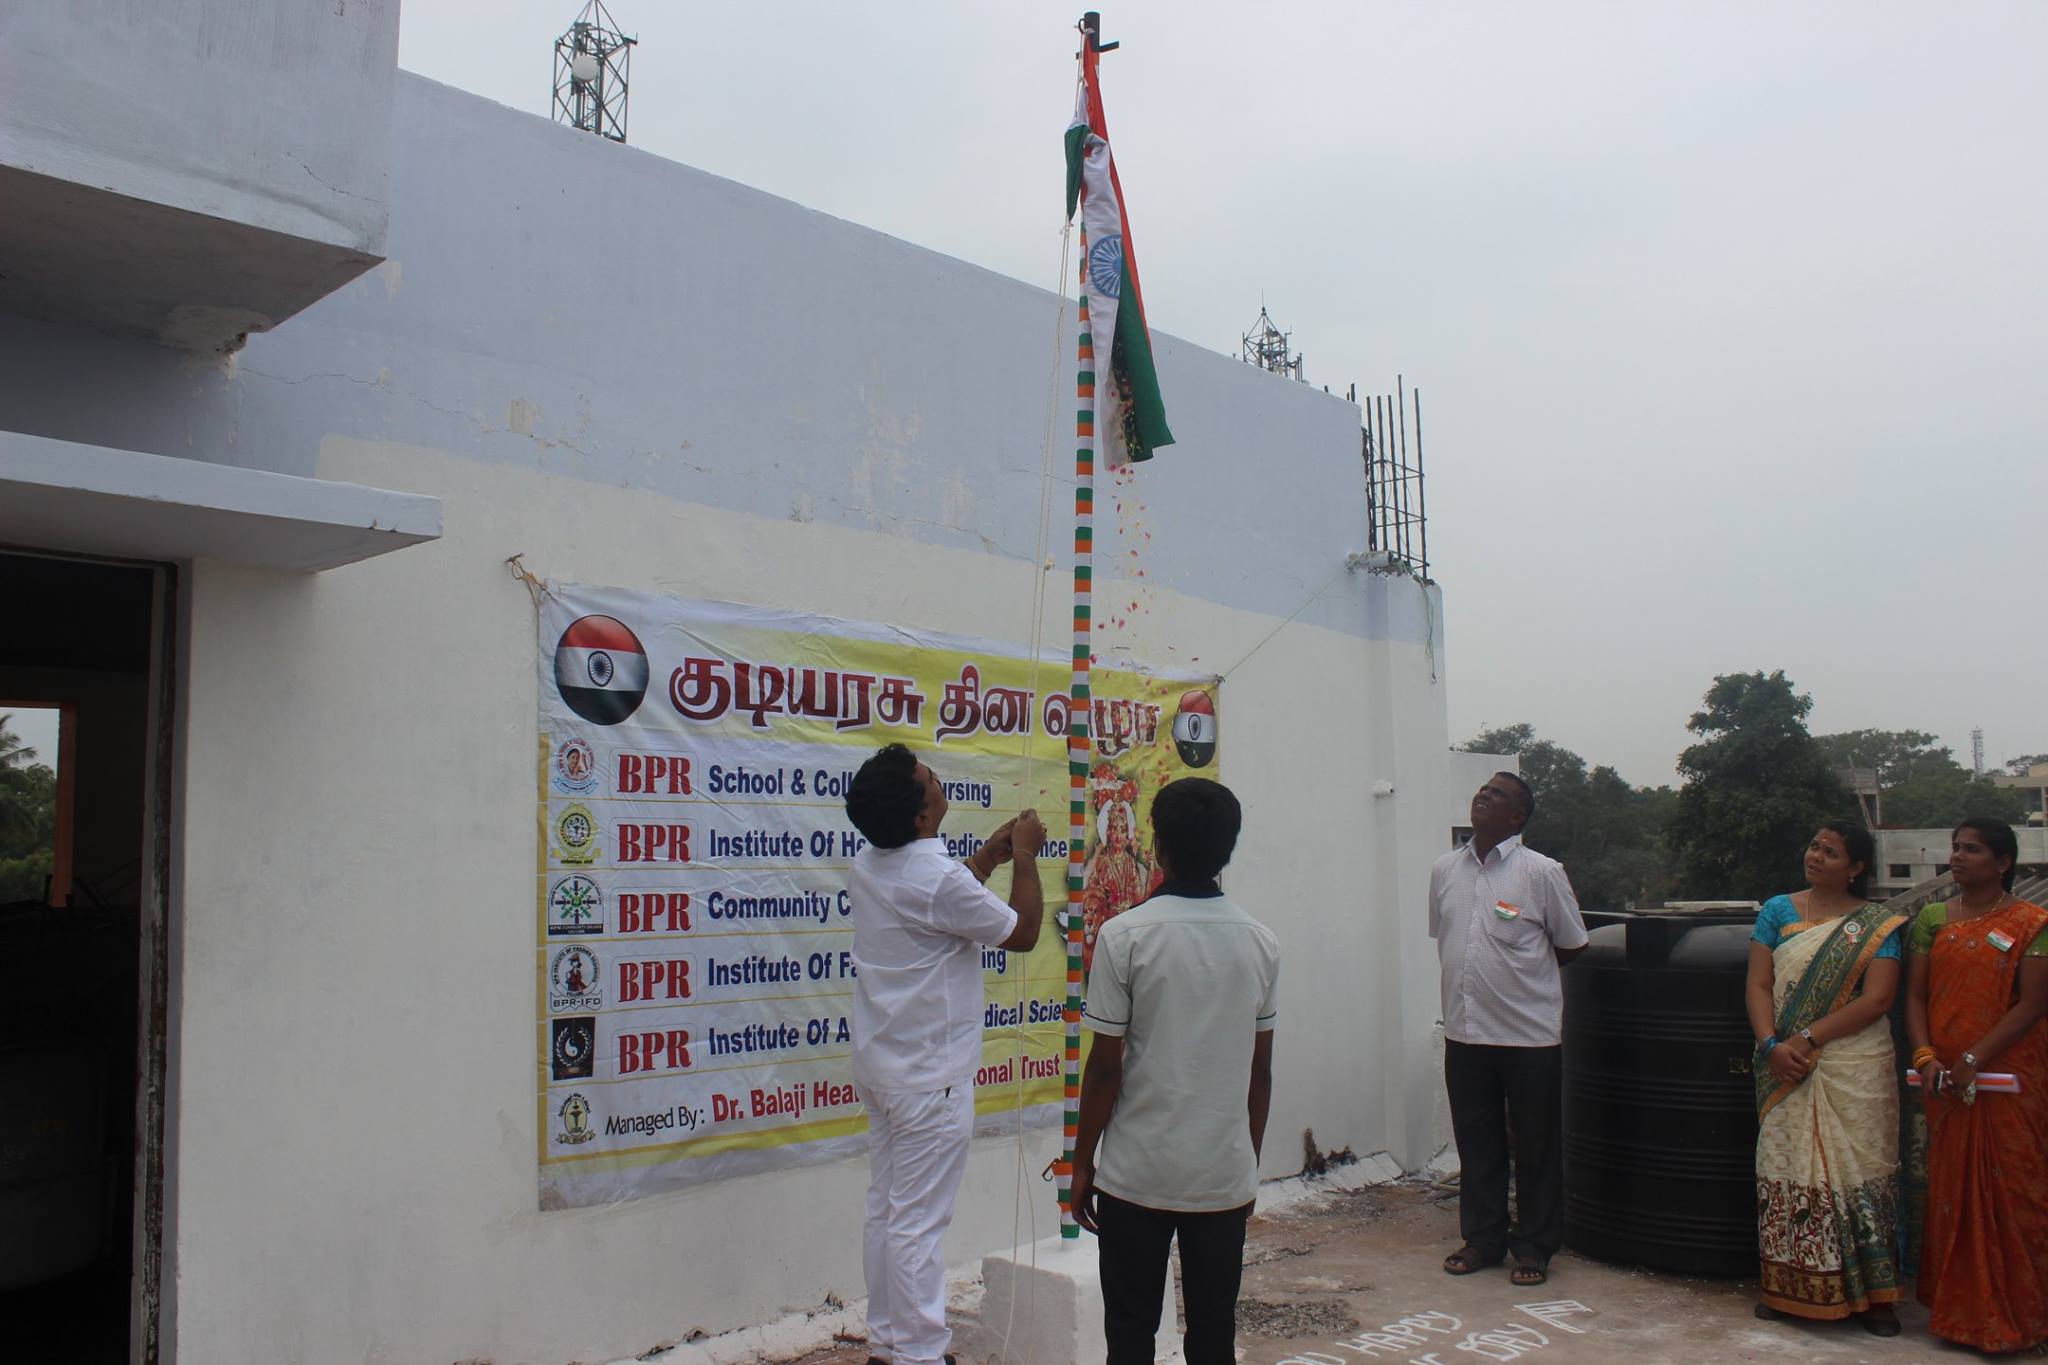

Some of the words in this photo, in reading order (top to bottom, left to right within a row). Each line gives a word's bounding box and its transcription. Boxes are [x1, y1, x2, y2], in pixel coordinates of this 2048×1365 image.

[669, 657, 924, 730] குடியரசு
[936, 665, 1034, 742] தின
[617, 754, 693, 795] BPR
[708, 765, 783, 795] School
[791, 769, 806, 796] &
[814, 770, 853, 797] Coll
[617, 824, 692, 863] BPR
[710, 829, 803, 858] Institute
[811, 831, 834, 858] Of
[617, 893, 692, 934] BPR
[708, 891, 830, 924] Community
[618, 959, 692, 1003] BPR
[708, 956, 801, 986] Institute
[808, 952, 832, 980] Of
[617, 1030, 692, 1075] BPR
[709, 1023, 800, 1055] Institute
[806, 1018, 829, 1045] Of
[984, 1000, 1023, 1028] dical
[605, 1110, 674, 1136] Managed
[679, 1106, 705, 1131] By:
[712, 1094, 744, 1122] Dr.
[751, 1083, 805, 1119] Balaji
[1020, 1053, 1060, 1080] Trust
[1335, 1310, 1463, 1357] HAPPY
[1456, 1322, 1550, 1362] DAY
